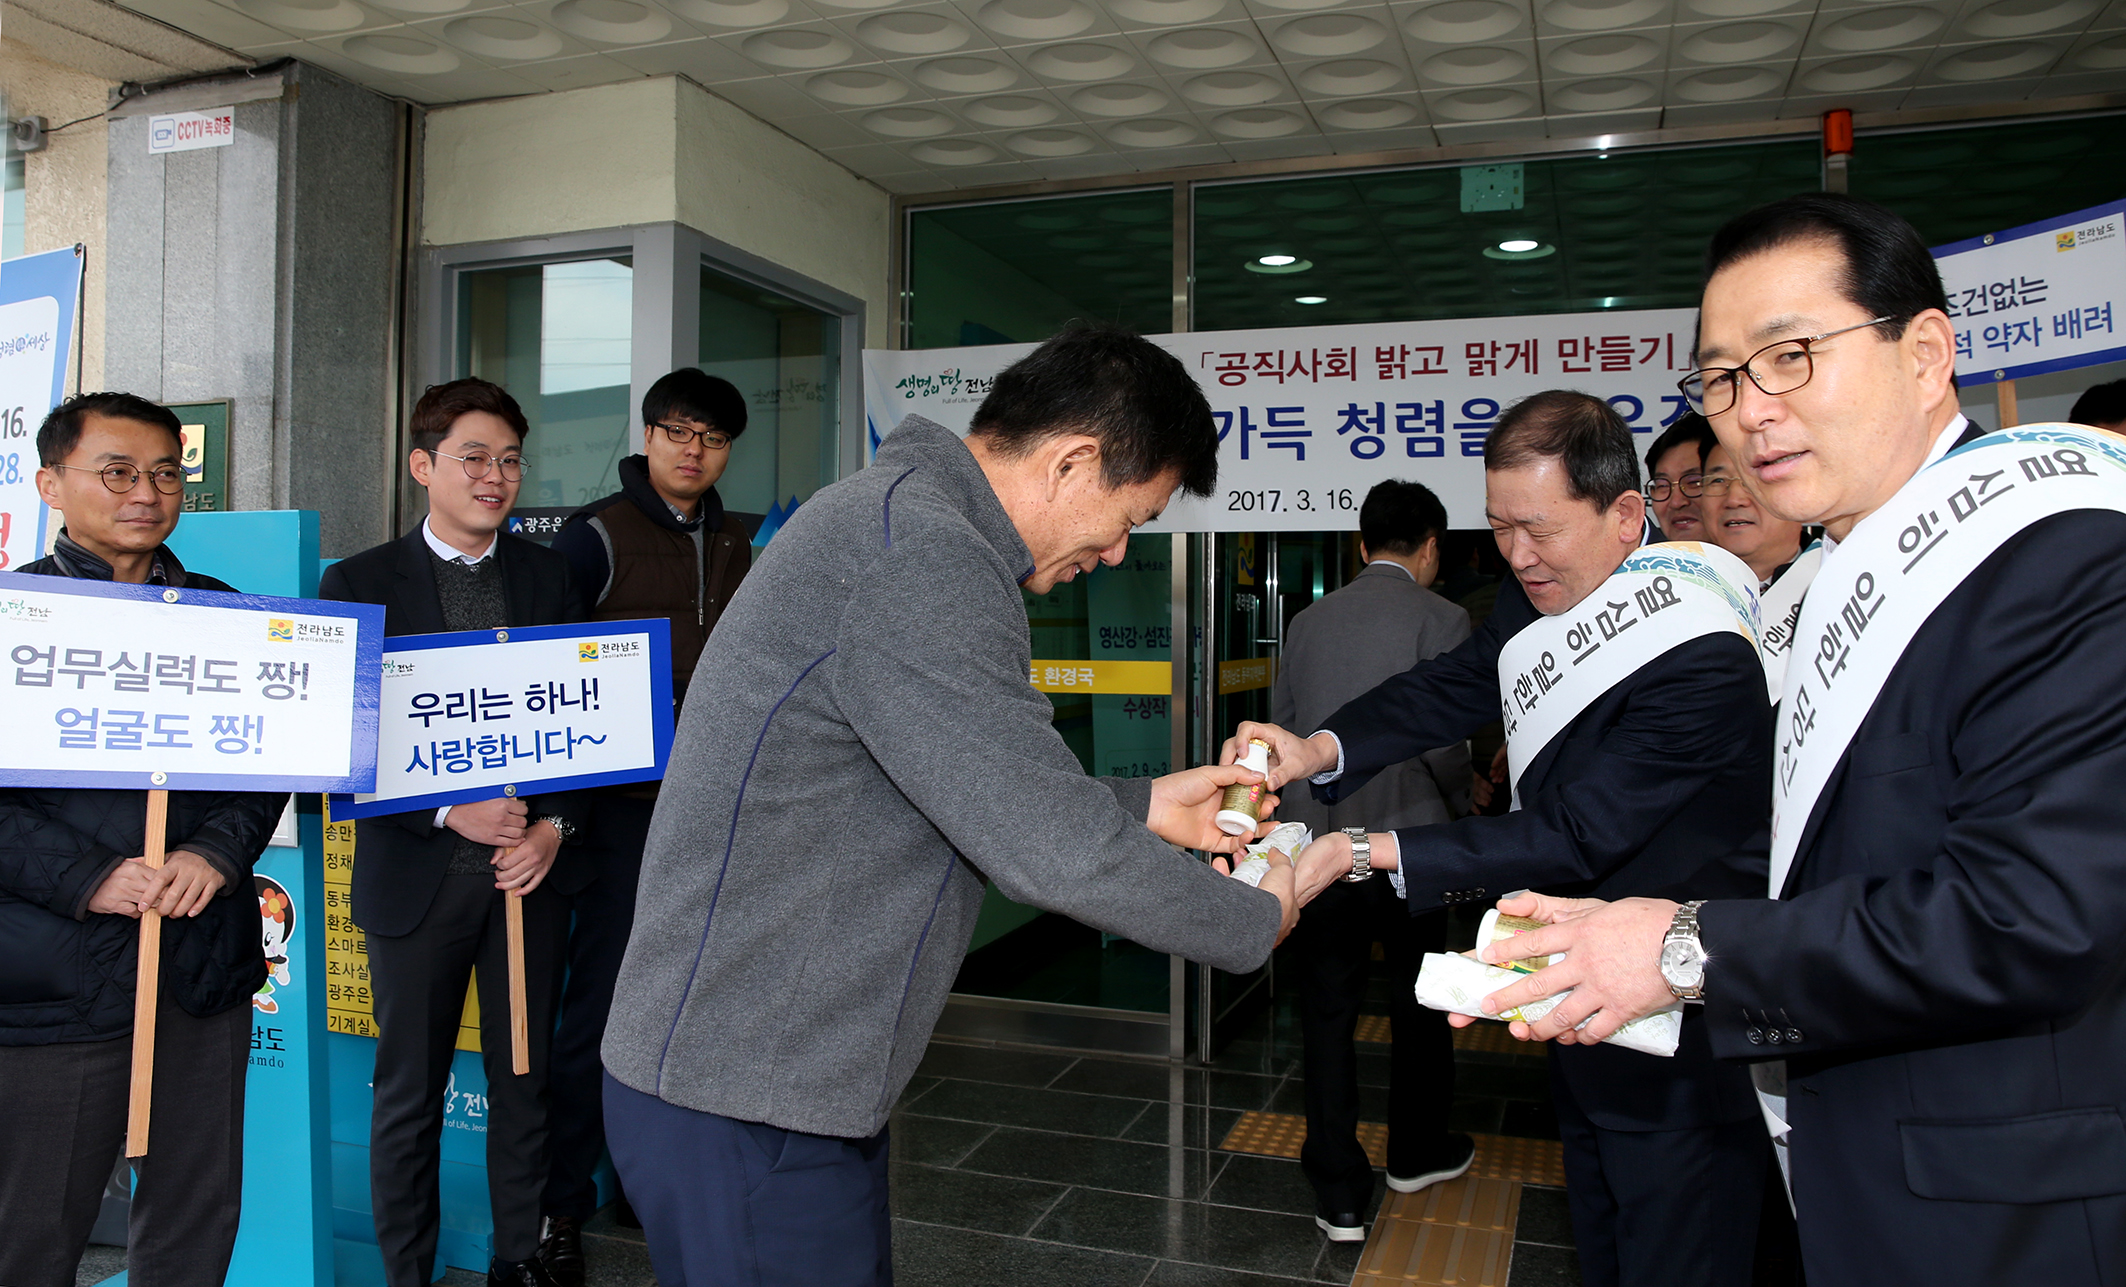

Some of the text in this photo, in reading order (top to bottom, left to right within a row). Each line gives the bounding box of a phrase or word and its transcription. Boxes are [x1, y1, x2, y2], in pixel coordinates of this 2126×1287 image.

[177, 116, 232, 141] CCTV녹화중
[2077, 222, 2115, 240] 전라남도
[1982, 316, 2043, 353] 약자
[2052, 301, 2114, 340] 배려
[1375, 344, 1449, 380] 밝고
[1465, 338, 1539, 377] 맑게
[938, 368, 963, 395] 땅
[965, 376, 994, 394] 전남
[1212, 406, 1313, 461] 가득
[1336, 398, 1500, 460] 청렴을
[1228, 489, 1358, 513] 2017. 3. 16.
[524, 516, 569, 533] 광주은
[27, 606, 52, 618] 전남
[297, 623, 345, 637] 전라남도
[1099, 626, 1172, 649] 영산강·섬진
[601, 641, 640, 654] 전라남도
[11, 644, 310, 701] 업무실력도 짱!
[1044, 667, 1095, 687] 환경국
[408, 678, 601, 728] 우리는 하나!
[1123, 696, 1168, 720] 수상작
[54, 707, 264, 755] 얼굴도 짱!
[325, 824, 357, 842] 송만
[327, 914, 366, 933] 환경
[328, 937, 368, 955] 스마트
[328, 960, 369, 981] 조사실
[328, 983, 374, 1004] 광주은
[448, 1120, 456, 1128] of
